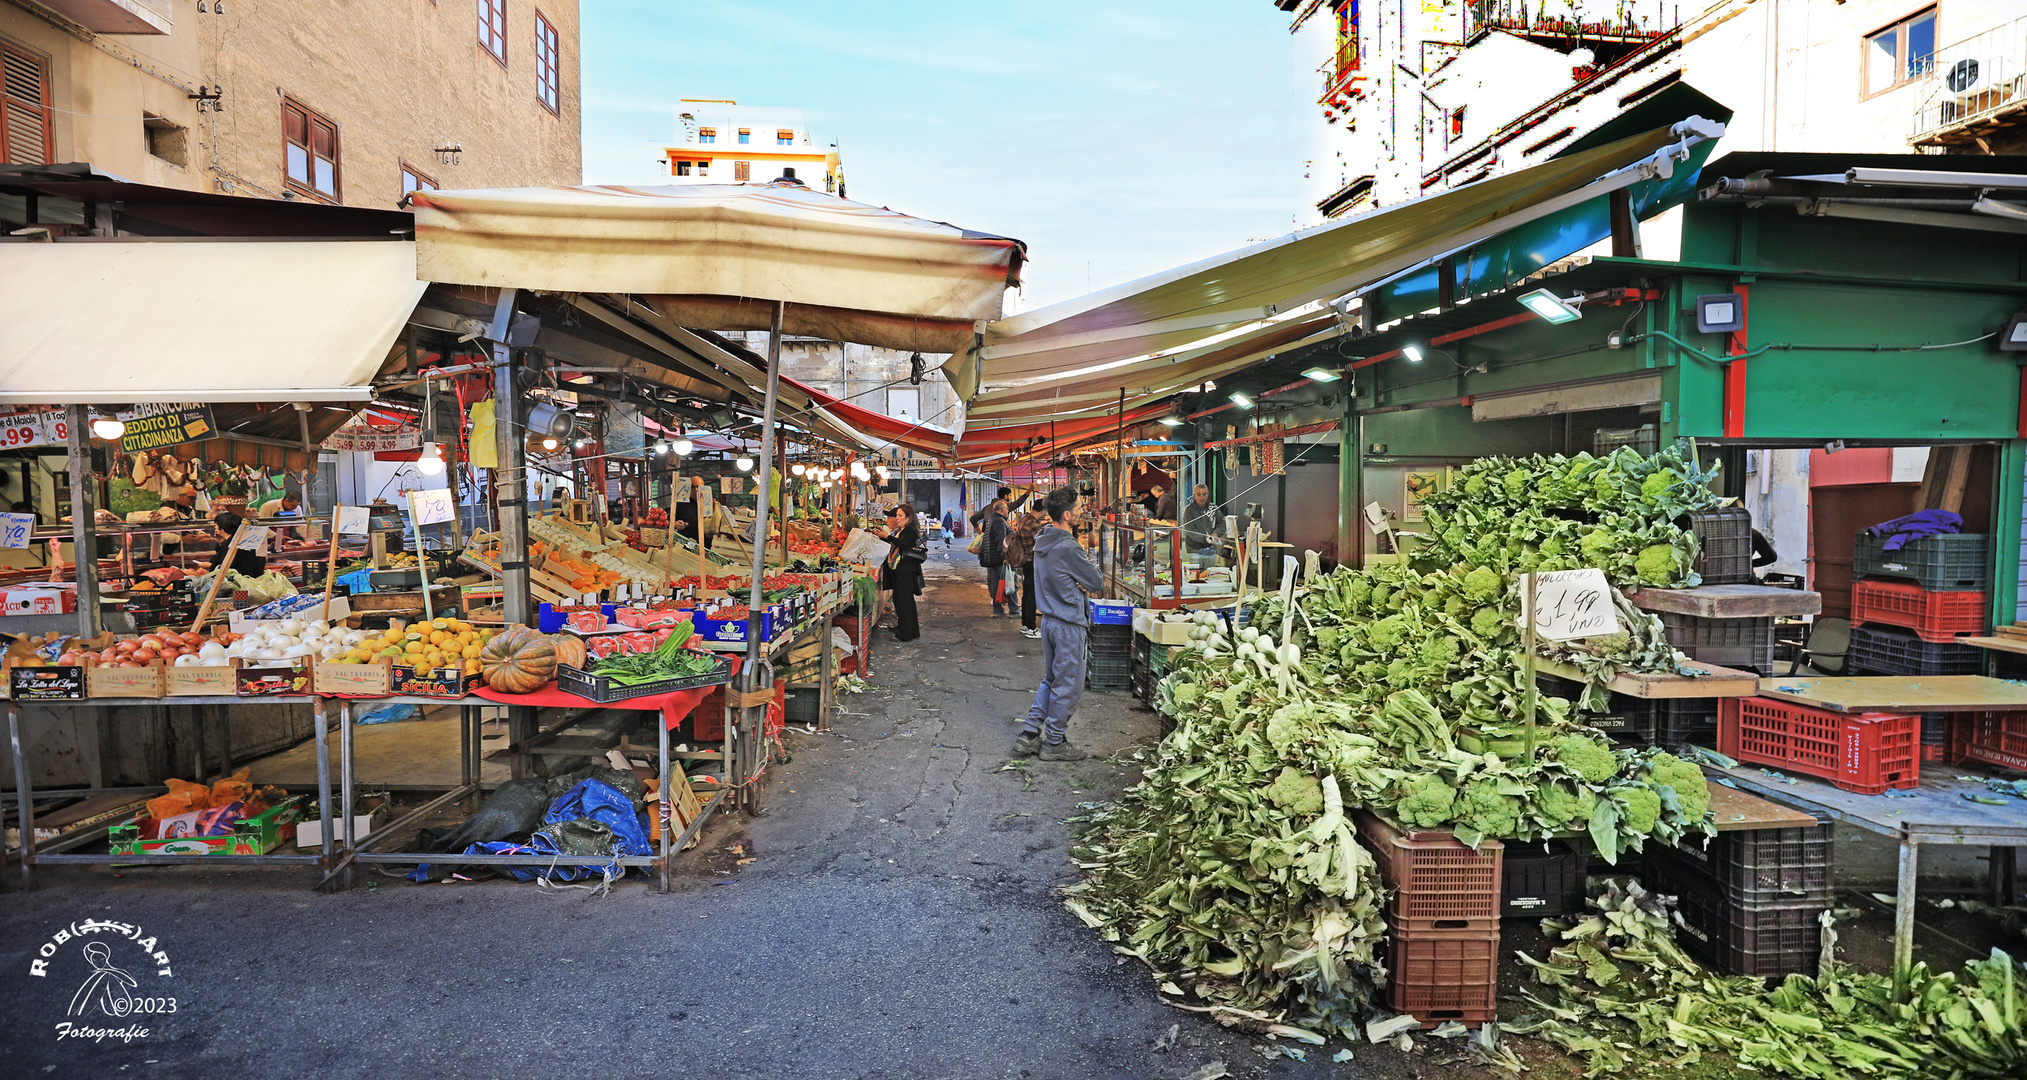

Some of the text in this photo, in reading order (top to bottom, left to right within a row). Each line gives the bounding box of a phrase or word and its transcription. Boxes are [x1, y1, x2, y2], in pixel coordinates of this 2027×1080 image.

[13, 414, 37, 426] Maiale
[52, 411, 66, 420] Tog
[167, 413, 181, 427] DI
[123, 427, 185, 451] CITTADINANZA
[336, 439, 354, 450] 5.99
[360, 440, 376, 451] 5.99
[401, 682, 447, 694] SICILIA
[1983, 750, 2027, 768] CAVALIERE
